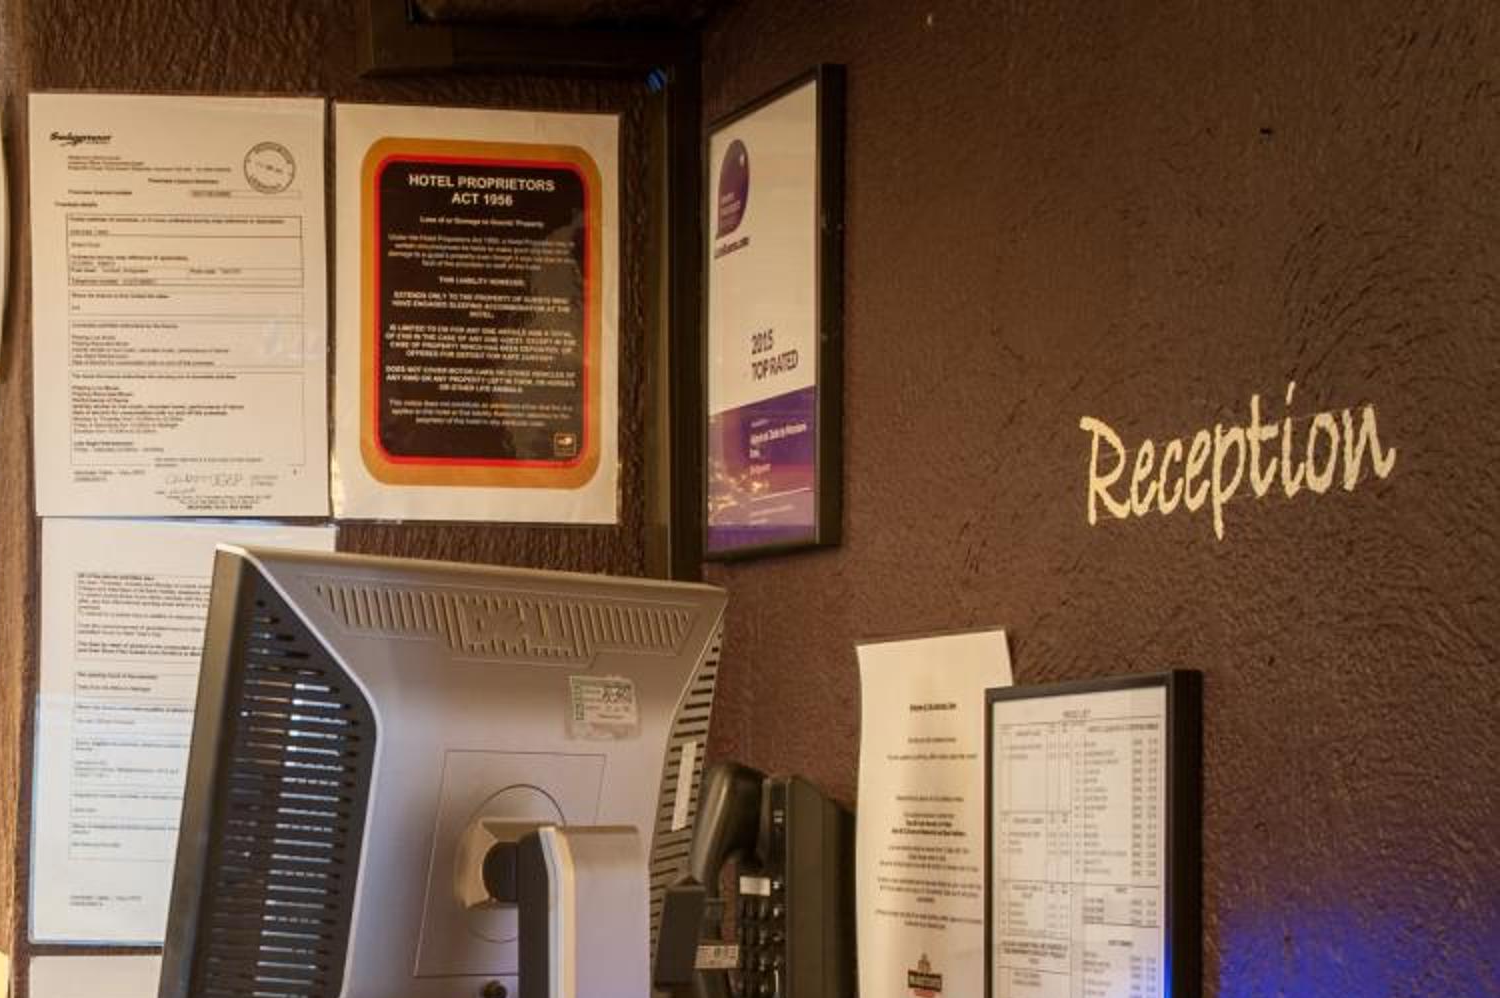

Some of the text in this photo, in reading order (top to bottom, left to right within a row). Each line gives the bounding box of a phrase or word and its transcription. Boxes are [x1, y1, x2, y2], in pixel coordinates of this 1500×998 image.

[408, 174, 555, 192] HOTEL PROPRIETORS
[451, 192, 513, 207] ACT 1956
[751, 329, 773, 356] 2015
[751, 349, 799, 381] TOP RATED
[1079, 380, 1398, 541] Reception
